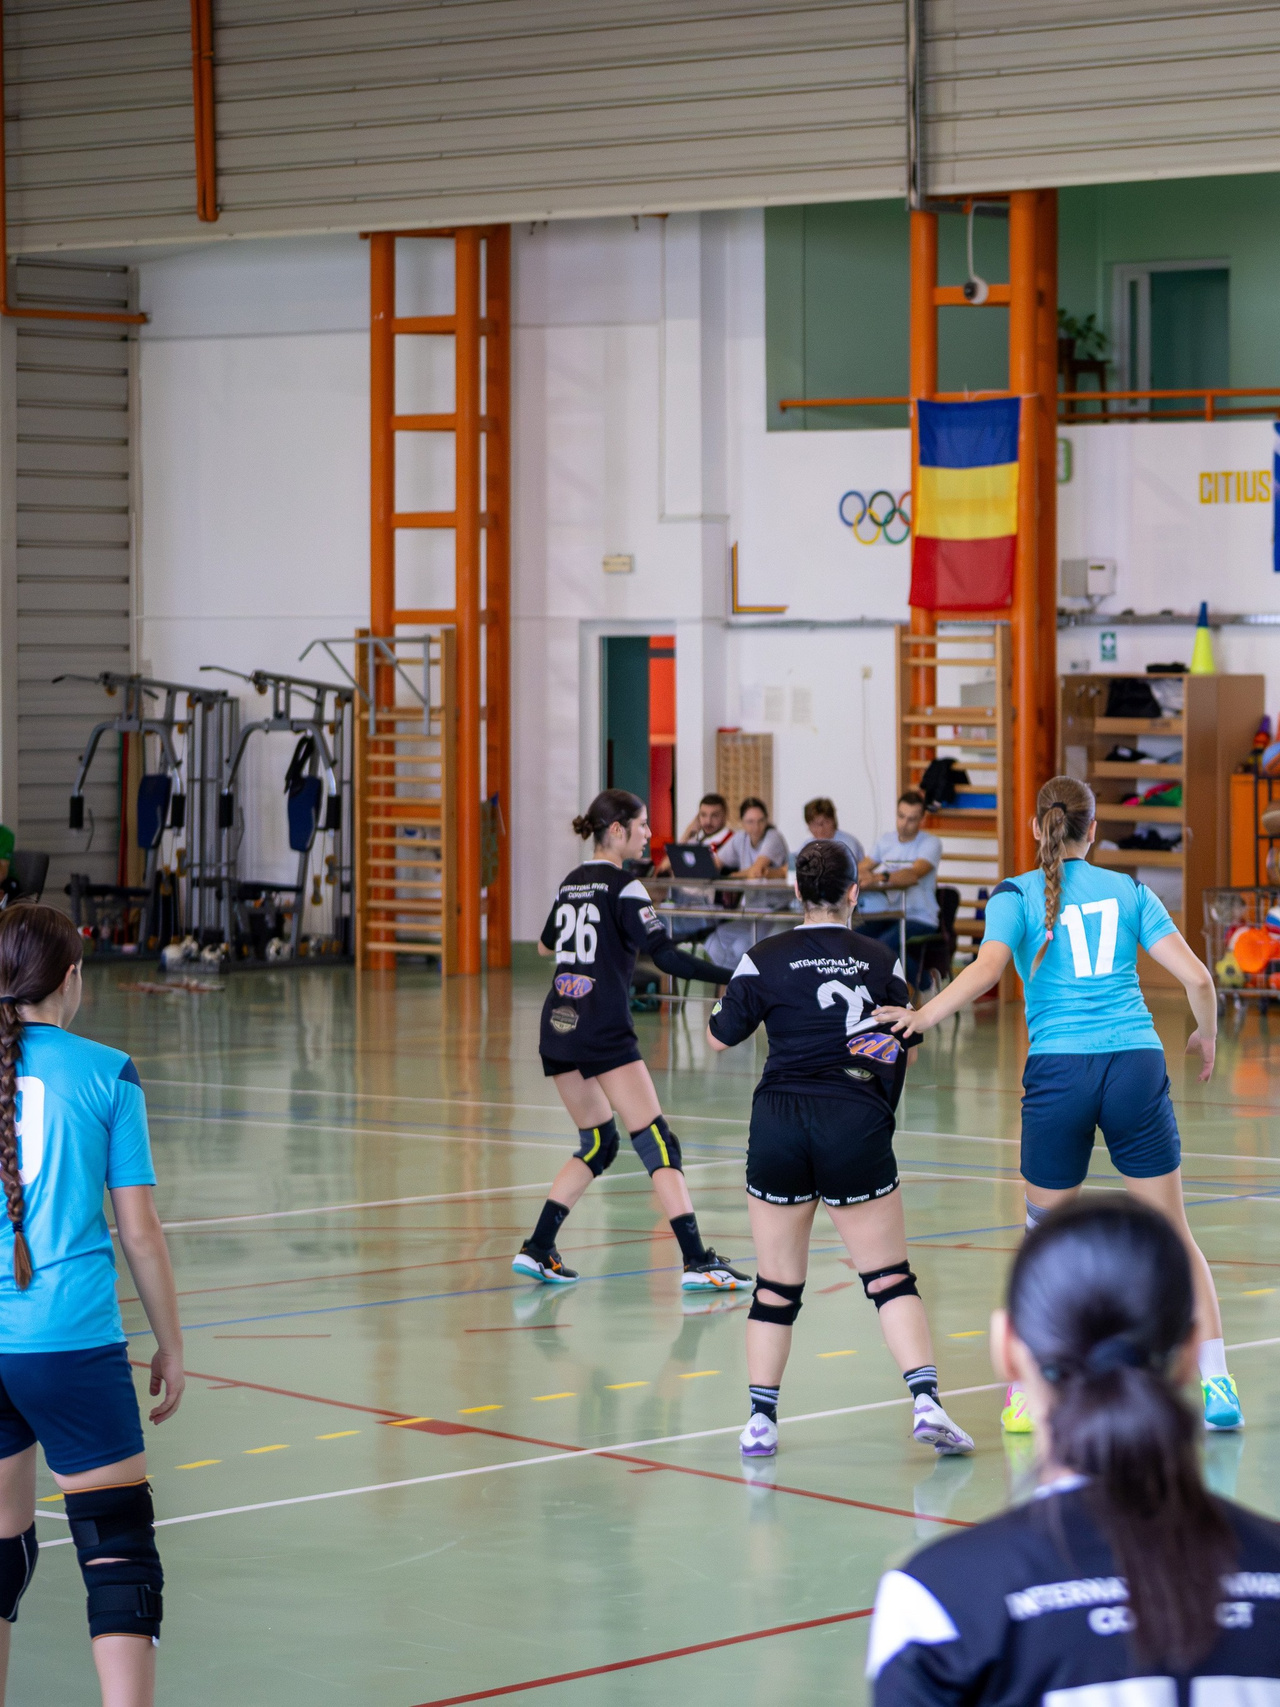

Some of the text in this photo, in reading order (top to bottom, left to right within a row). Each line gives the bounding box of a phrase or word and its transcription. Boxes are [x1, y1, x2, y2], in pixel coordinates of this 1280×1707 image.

[1200, 471, 1271, 504] CITIUS
[555, 902, 600, 965] 26
[1060, 898, 1119, 979] 17
[765, 1193, 789, 1204] Kempa
[846, 1194, 870, 1204] Kempa
[875, 1183, 894, 1197] Kempa
